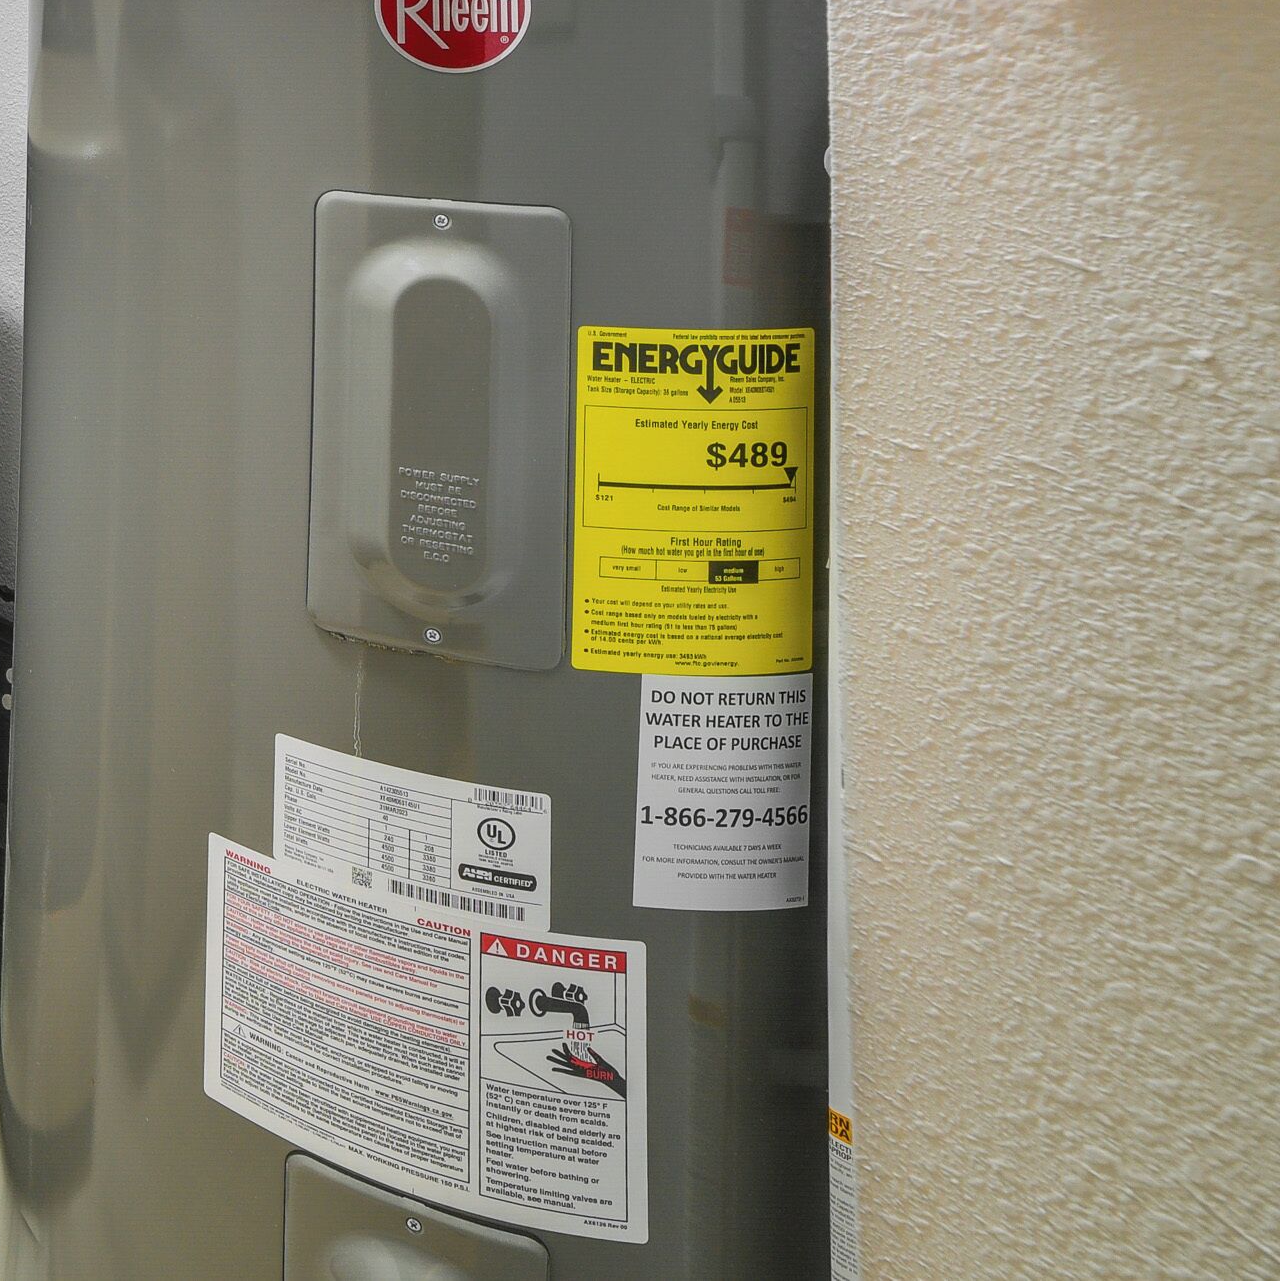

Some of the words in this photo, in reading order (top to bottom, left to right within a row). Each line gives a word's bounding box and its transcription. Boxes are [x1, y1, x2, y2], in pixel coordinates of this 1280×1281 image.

[593, 341, 800, 375] ENERGYGUIDE
[587, 375, 602, 383] Water
[604, 376, 621, 384] Heater
[630, 377, 656, 385] ELECTRIC
[601, 386, 613, 394] Size
[670, 389, 688, 397] gallons
[635, 419, 678, 429] Estimated
[682, 420, 709, 431] Yearly
[712, 421, 739, 431] Energy
[742, 420, 758, 429] Cost
[706, 441, 788, 471] $489
[399, 467, 435, 479] POWER
[440, 472, 479, 486] SUPPLY
[415, 480, 443, 491] MUST
[448, 485, 462, 495] BE
[400, 489, 476, 508] DISCONNECTED
[418, 504, 457, 517] BEFORE
[657, 504, 670, 512] Cost
[672, 505, 690, 513] Range
[410, 514, 465, 530] ADJUSTING
[402, 524, 473, 543] THERMOSTAT
[670, 537, 690, 546] First
[693, 538, 713, 546] Hour
[716, 538, 742, 548] Rating
[401, 535, 414, 545] OR
[420, 539, 473, 555] RESETTING
[651, 690, 675, 704] DO
[681, 692, 714, 705] NOT
[718, 692, 775, 706] RETURN
[779, 689, 806, 704] THIS
[646, 712, 701, 728] WATER
[706, 715, 760, 728] HEATER
[764, 715, 782, 728] TO
[785, 712, 809, 726] THE
[654, 735, 702, 750] PLACE
[706, 738, 727, 751] OF
[731, 735, 802, 751] PURCHASE
[640, 804, 808, 828] 1-866-279-4566
[486, 823, 506, 845] UL
[381, 844, 394, 853] 4500
[485, 849, 508, 858] LISTED
[226, 848, 272, 874] WARNING
[381, 854, 394, 863] 4500
[296, 879, 330, 896] ELECTRIC
[332, 892, 357, 905] WATER
[358, 901, 388, 914] HEATER
[417, 918, 472, 937] CAUTION
[516, 944, 617, 970] DANGER
[567, 1030, 595, 1041] HOT
[586, 1069, 613, 1081] BURN
[486, 1084, 510, 1094] Water
[512, 1089, 562, 1104] temperature
[505, 1096, 513, 1104] C)
[516, 1099, 530, 1107] can
[532, 1102, 558, 1112] cause
[559, 1107, 586, 1116] severe
[588, 1110, 611, 1118] burns
[486, 1111, 524, 1126] Children,
[526, 1120, 560, 1132] disabled
[562, 1124, 578, 1134] and
[579, 1129, 606, 1140] elderly
[534, 1110, 557, 1120] death
[559, 1114, 578, 1123] from
[580, 1117, 608, 1127] scalds.
[496, 1122, 527, 1134] highest
[528, 1129, 544, 1138] risk
[546, 1131, 555, 1139] of
[556, 1133, 579, 1144] being
[581, 1138, 614, 1148] scalded.
[348, 1145, 365, 1157] MAX.
[366, 1153, 400, 1170] WORKING
[401, 1166, 439, 1183] PRESSURE
[440, 1179, 453, 1188] 150
[453, 1183, 470, 1192] P.S.I.
